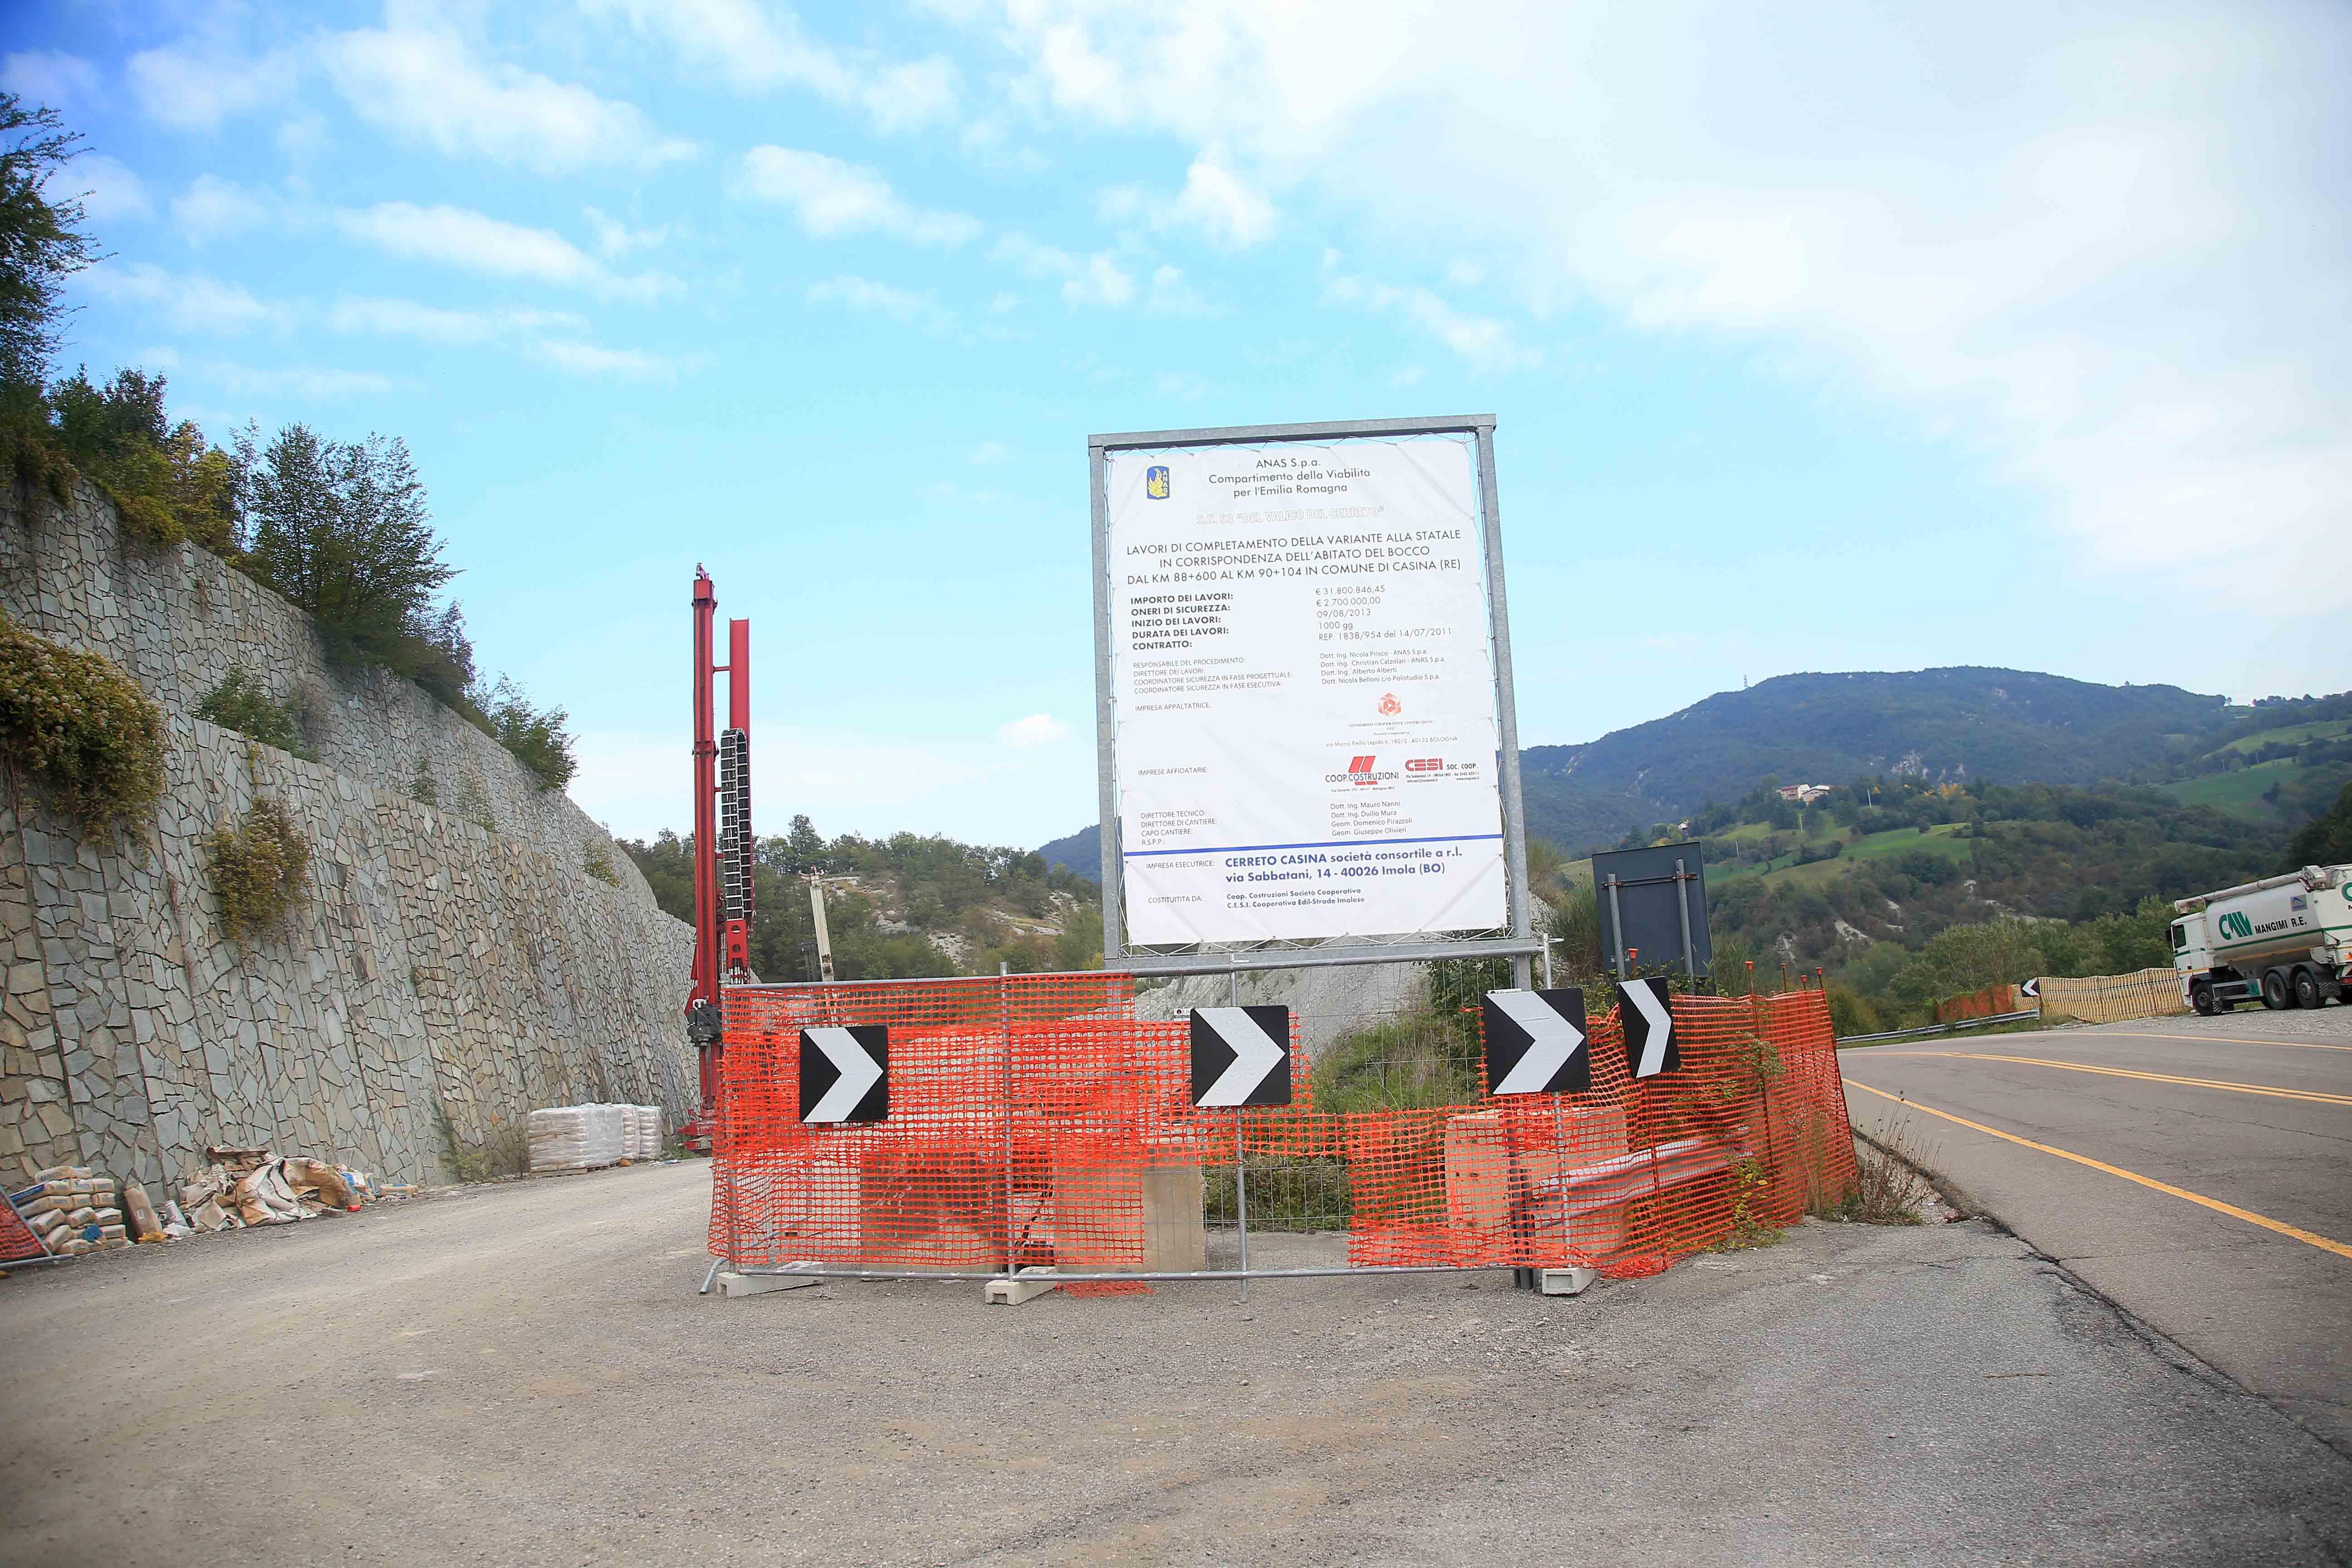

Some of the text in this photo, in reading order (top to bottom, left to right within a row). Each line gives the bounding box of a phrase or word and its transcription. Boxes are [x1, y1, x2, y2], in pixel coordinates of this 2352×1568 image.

[1256, 458, 1321, 468] ANAS S.p.a.
[1209, 468, 1370, 485] Compartimento della Viabilità
[1234, 484, 1347, 499] per l'Emilia Romagna
[1196, 514, 1217, 525] S.S.
[1219, 512, 1234, 524] 63
[1264, 510, 1304, 522] VALICO
[1306, 509, 1327, 519] DEL
[1127, 529, 1460, 555] LAVORI DI COMPLETAMENTO DELLA VARIANTE ALLA STATALE
[1160, 546, 1430, 568] IN CORRISPONDENZA DELL'ABITATO DEL BOCCO
[1127, 559, 1460, 584] DAL KM 88+600 AL KM 90+104 IN COMUNE DI CASINA (RE)
[1323, 584, 1385, 595] 31.800.846,45
[1130, 595, 1175, 605] IMPORTO
[1195, 593, 1233, 601] LAVORI:
[1324, 596, 1380, 606] 2.700.000,00
[1131, 608, 1160, 616] ONERI
[1176, 604, 1230, 613] SICUREZZA:
[1317, 608, 1371, 619] 09/08/2013
[1132, 616, 1220, 628] INIZIO DEI LAVORI:
[1132, 630, 1171, 638] DURATA
[1191, 627, 1229, 635] LAVORI:
[1339, 631, 1381, 640] 1838/954
[1384, 629, 1396, 638] del
[1399, 627, 1450, 637] 14/07/2011
[1132, 640, 1192, 650] CONTRATTO:
[1193, 657, 1245, 665] PROCEDIMENTO:
[1134, 677, 1184, 685] COORDINATORE
[1134, 686, 1185, 694] COORDINATORE
[1405, 758, 1443, 771] CESI
[1225, 856, 1277, 867] CERRETO
[1280, 853, 1327, 865] CASINA
[1330, 851, 1372, 862] società
[1375, 848, 1432, 860] consortile
[1446, 846, 1462, 857] r.l.
[1225, 862, 1445, 882] via Sabbatani, 14 40026 Imola (BO)
[1317, 887, 1361, 896] Cooperativa
[1252, 900, 1296, 908] Cooperativa
[2254, 919, 2288, 934] MANGIMI
[2291, 916, 2307, 927] R.E.
